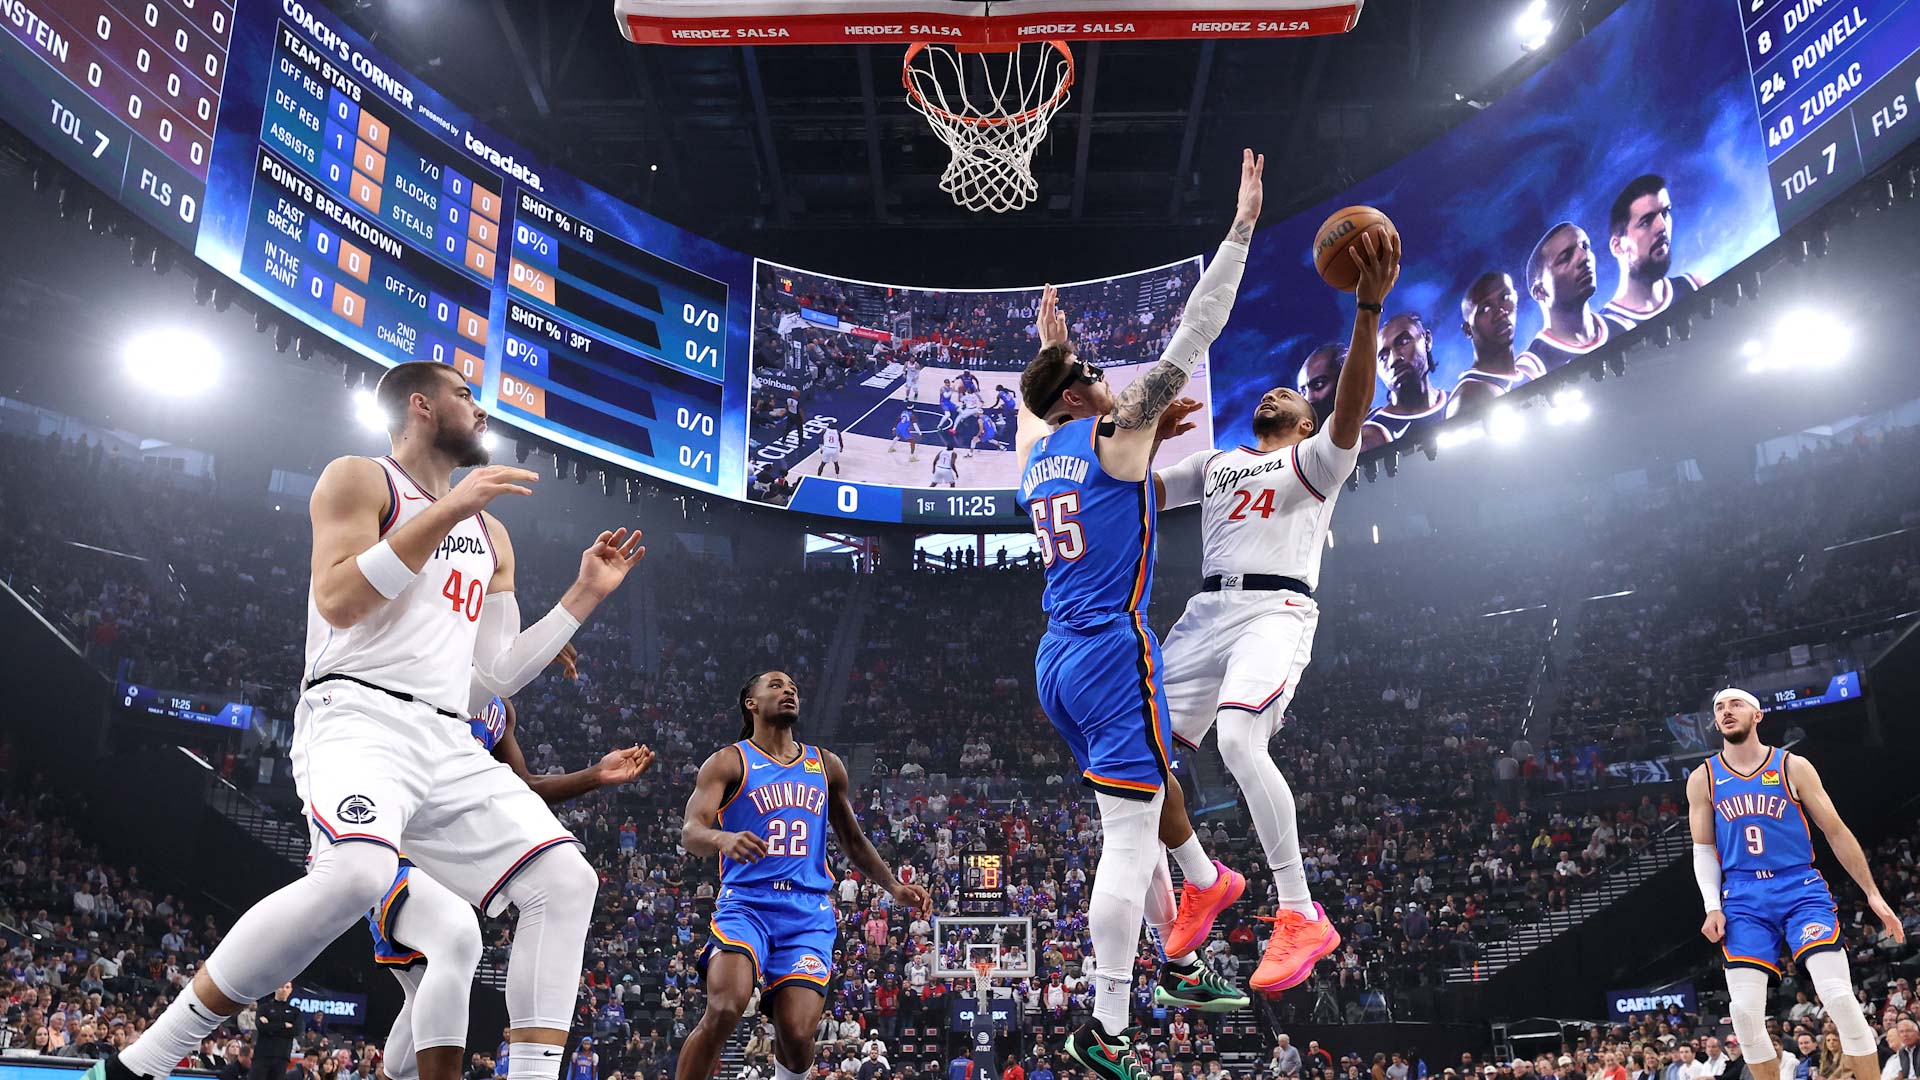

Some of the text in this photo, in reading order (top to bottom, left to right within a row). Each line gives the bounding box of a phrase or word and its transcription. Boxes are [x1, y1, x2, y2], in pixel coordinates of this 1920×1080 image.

[145, 3, 218, 77] 0 0 0
[212, 10, 225, 34] 0
[671, 28, 790, 40] HERDEZ SALSA
[844, 25, 962, 36] HERDEZ SALSA
[1017, 23, 1135, 35] HERDEZ SALSA
[1191, 21, 1309, 32] HERDEZ SALSA
[281, 0, 415, 110] COACH'S CORNER
[1757, 30, 1772, 55] 8
[1760, 6, 1867, 105] 24 POWELL
[97, 15, 211, 121] 0 0 0 0
[283, 29, 362, 102] TEAM STATS
[87, 62, 103, 88] 0
[128, 94, 142, 120] 0
[159, 118, 173, 143] 0
[189, 142, 203, 165] 0
[280, 57, 379, 142] OFF REB 0 0
[1768, 115, 1794, 148] 40
[1799, 62, 1864, 126] ZUBAC
[1871, 94, 1908, 137] FLS
[51, 98, 110, 159] TOL 7
[275, 88, 375, 172] DEF REB 1 0
[450, 123, 460, 137] by
[270, 122, 370, 203] ASSISTS 0 0
[1781, 142, 1837, 200] TOL 7
[140, 168, 196, 224] FLS 0
[419, 157, 490, 211] T/O 0 0
[262, 155, 403, 260] POINTS BREAKDOWN
[267, 209, 302, 243] BREAK
[395, 175, 487, 240] BLOCKS 0 0
[522, 195, 594, 243] SHOT % FG
[277, 198, 360, 273] FAST 0 0
[392, 205, 485, 268] STEALS 0 0
[517, 226, 548, 256] 0%
[264, 239, 300, 273] IN THE
[265, 260, 354, 317] PAINT 0 0
[513, 263, 545, 293] 0%
[385, 276, 478, 338] OFF T/O 0 0
[683, 303, 719, 333] 0/0
[377, 325, 416, 355] CHANCE
[511, 305, 591, 353] SHOT % 3PT
[397, 323, 474, 378] 2ND 0 0
[506, 337, 538, 367] 0%
[685, 339, 717, 368] 0/1
[502, 377, 534, 405] 0%
[676, 407, 714, 437] 0/0
[679, 445, 712, 473] 0/1
[1023, 455, 1089, 499] HARTENSTEIN
[1206, 459, 1284, 497] Clippers
[837, 485, 996, 516] 0 1ST 11:25
[1228, 489, 1275, 520] 24
[1030, 490, 1087, 567] 55
[442, 568, 483, 622] 40
[171, 698, 191, 710] 11:25
[1775, 690, 1796, 702] 11:25
[749, 783, 825, 815] THUNDER
[1717, 794, 1787, 822] THUNDER
[767, 819, 808, 856] 22
[1745, 825, 1763, 855] 9
